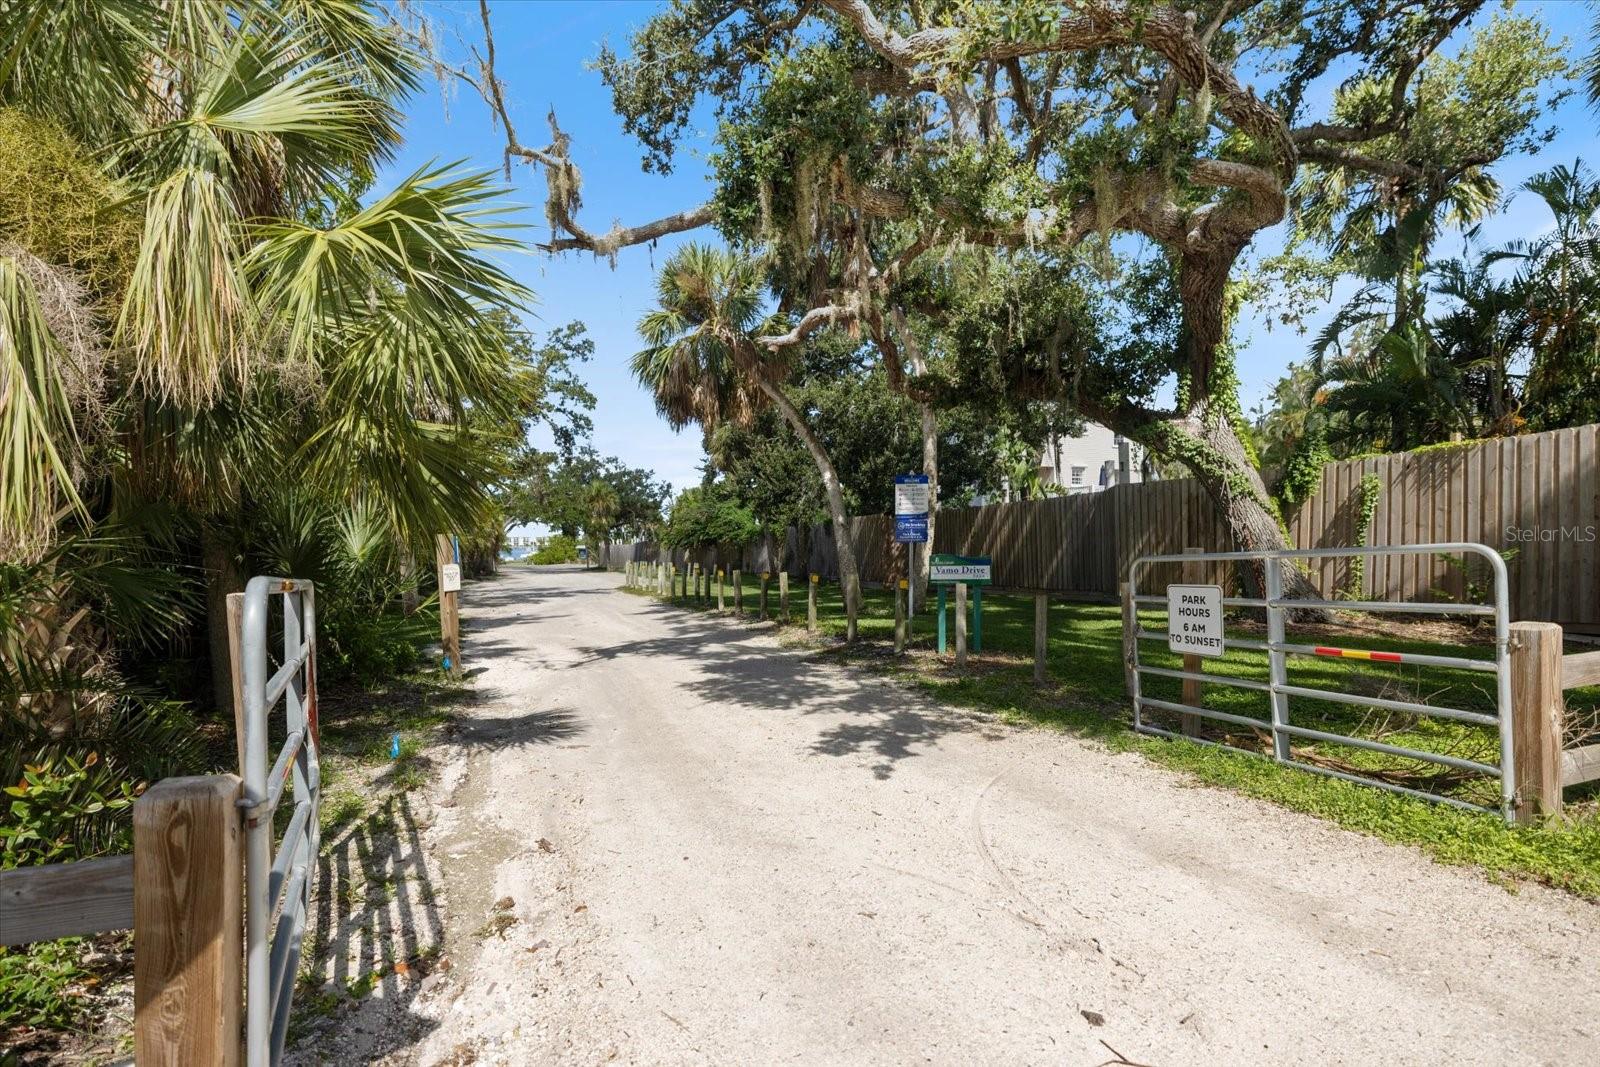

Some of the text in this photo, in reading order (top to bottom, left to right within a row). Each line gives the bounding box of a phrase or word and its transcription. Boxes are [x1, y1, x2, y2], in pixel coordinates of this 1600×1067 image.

[936, 566, 986, 574] Vamo Drive
[1182, 595, 1206, 604] PARK
[1178, 608, 1210, 618] HOURS
[1184, 622, 1206, 633] 6 AM
[1170, 634, 1220, 647] TO SUNSET
